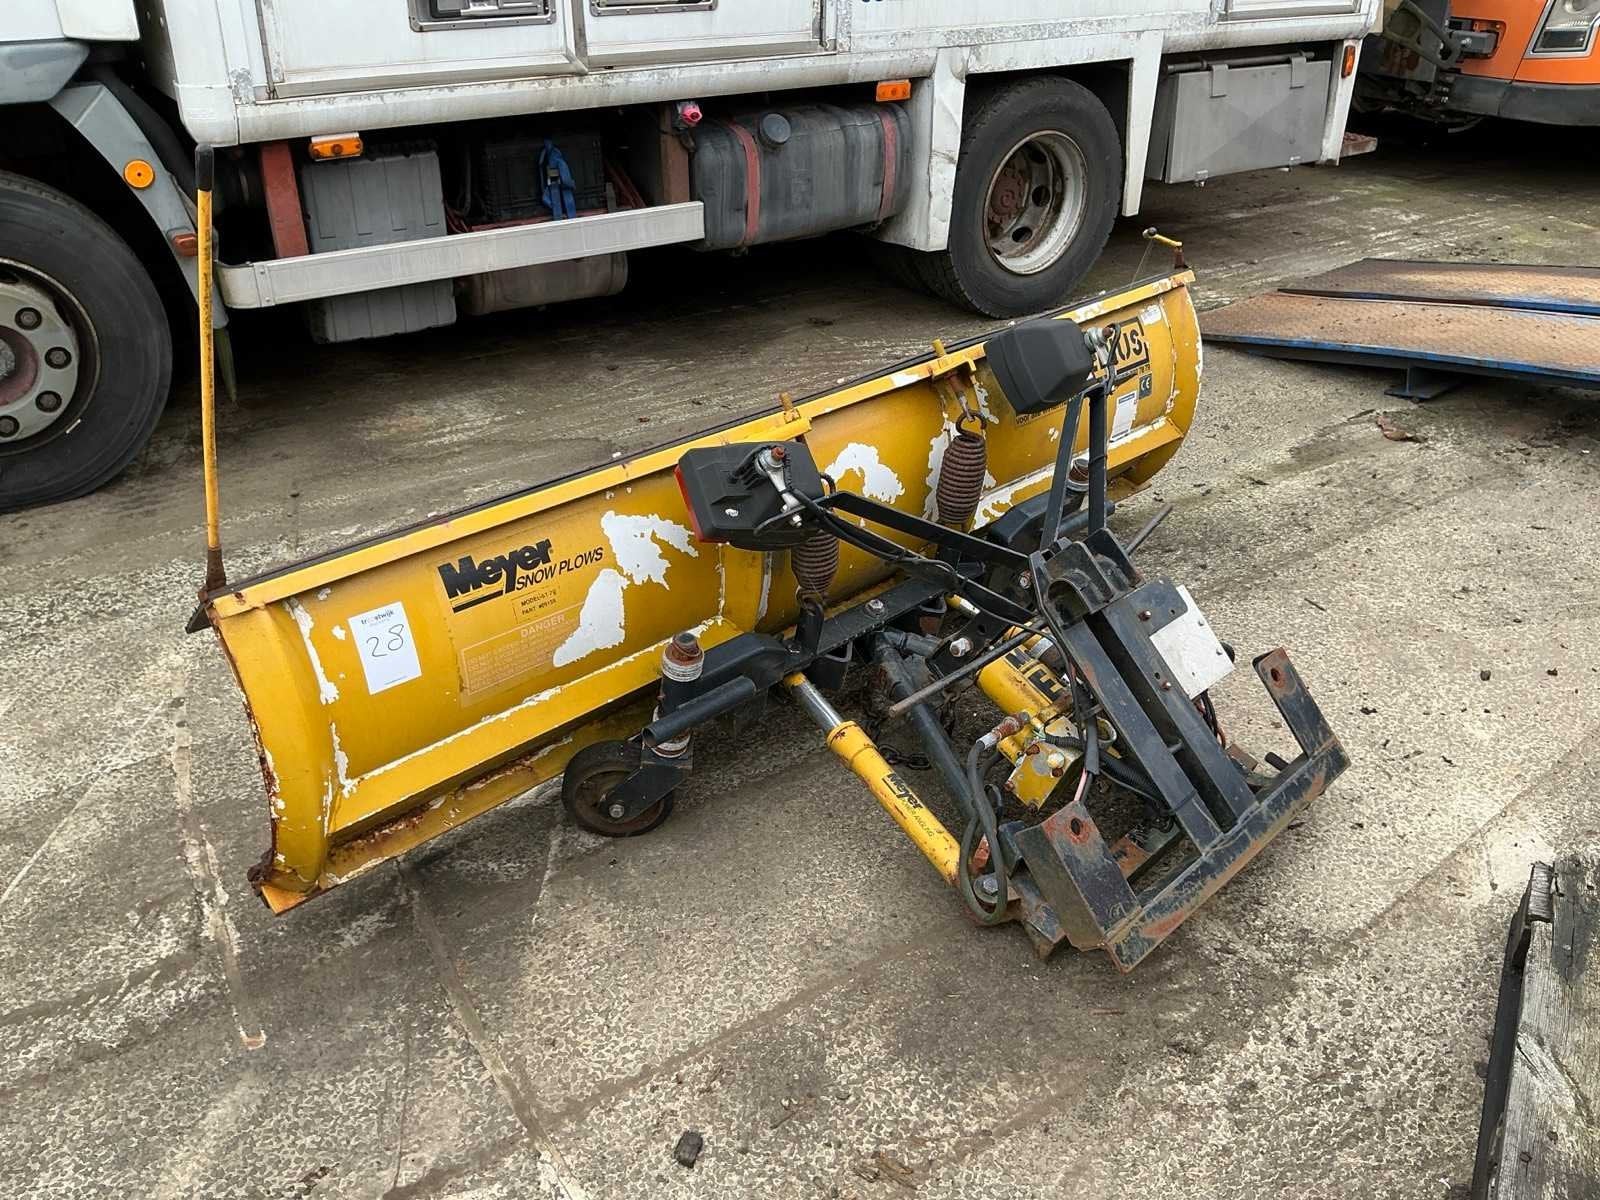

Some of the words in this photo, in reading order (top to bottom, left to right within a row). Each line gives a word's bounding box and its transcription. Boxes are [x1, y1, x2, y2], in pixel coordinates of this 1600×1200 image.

[438, 539, 552, 599] Meyer
[516, 563, 557, 591] SNOW
[559, 547, 603, 575] PLOWS
[366, 623, 404, 657] 28
[521, 614, 566, 638] DANGER
[886, 773, 924, 809] Meyer
